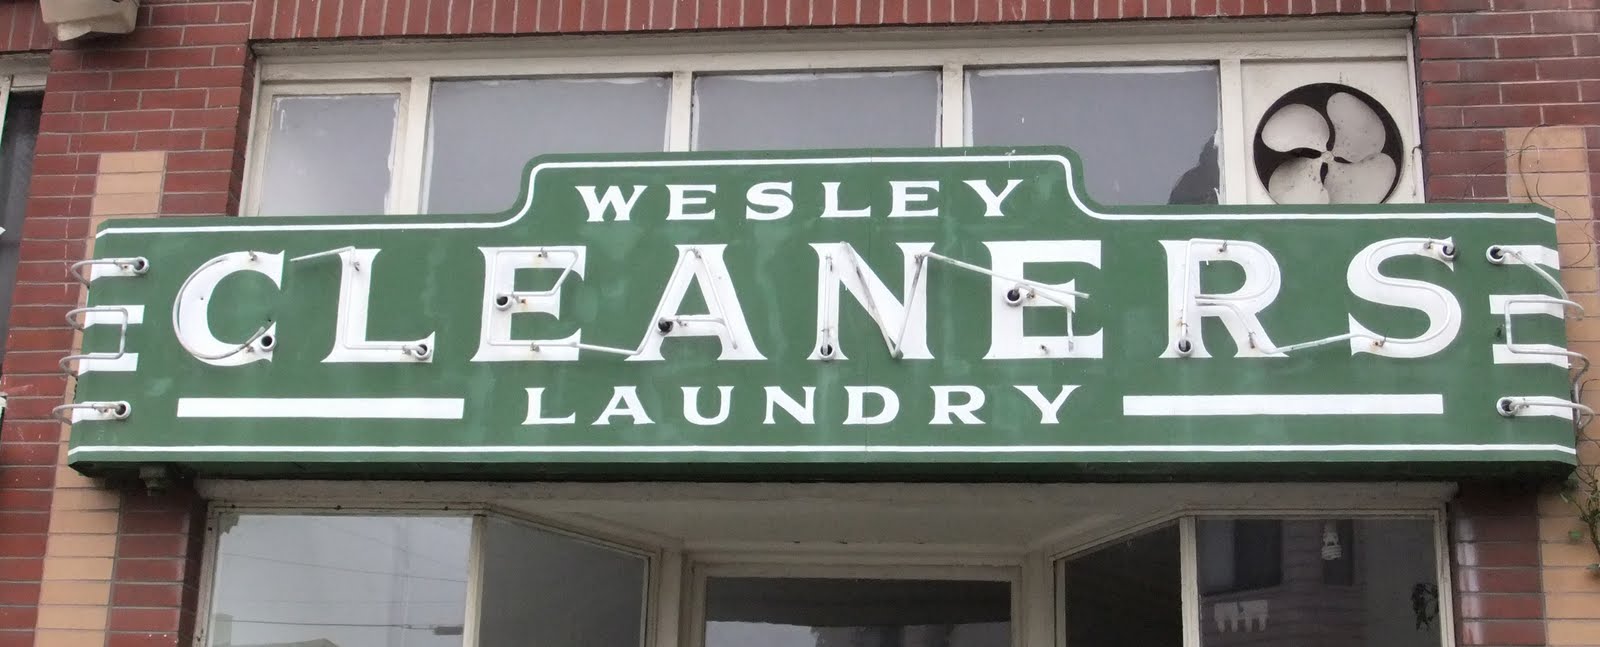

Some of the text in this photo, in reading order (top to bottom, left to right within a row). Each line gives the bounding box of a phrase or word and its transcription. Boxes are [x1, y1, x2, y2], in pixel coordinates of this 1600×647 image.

[574, 179, 1024, 222] WESLEY
[173, 236, 1464, 366] CLEANERS
[522, 384, 1080, 426] LAUNDRY
